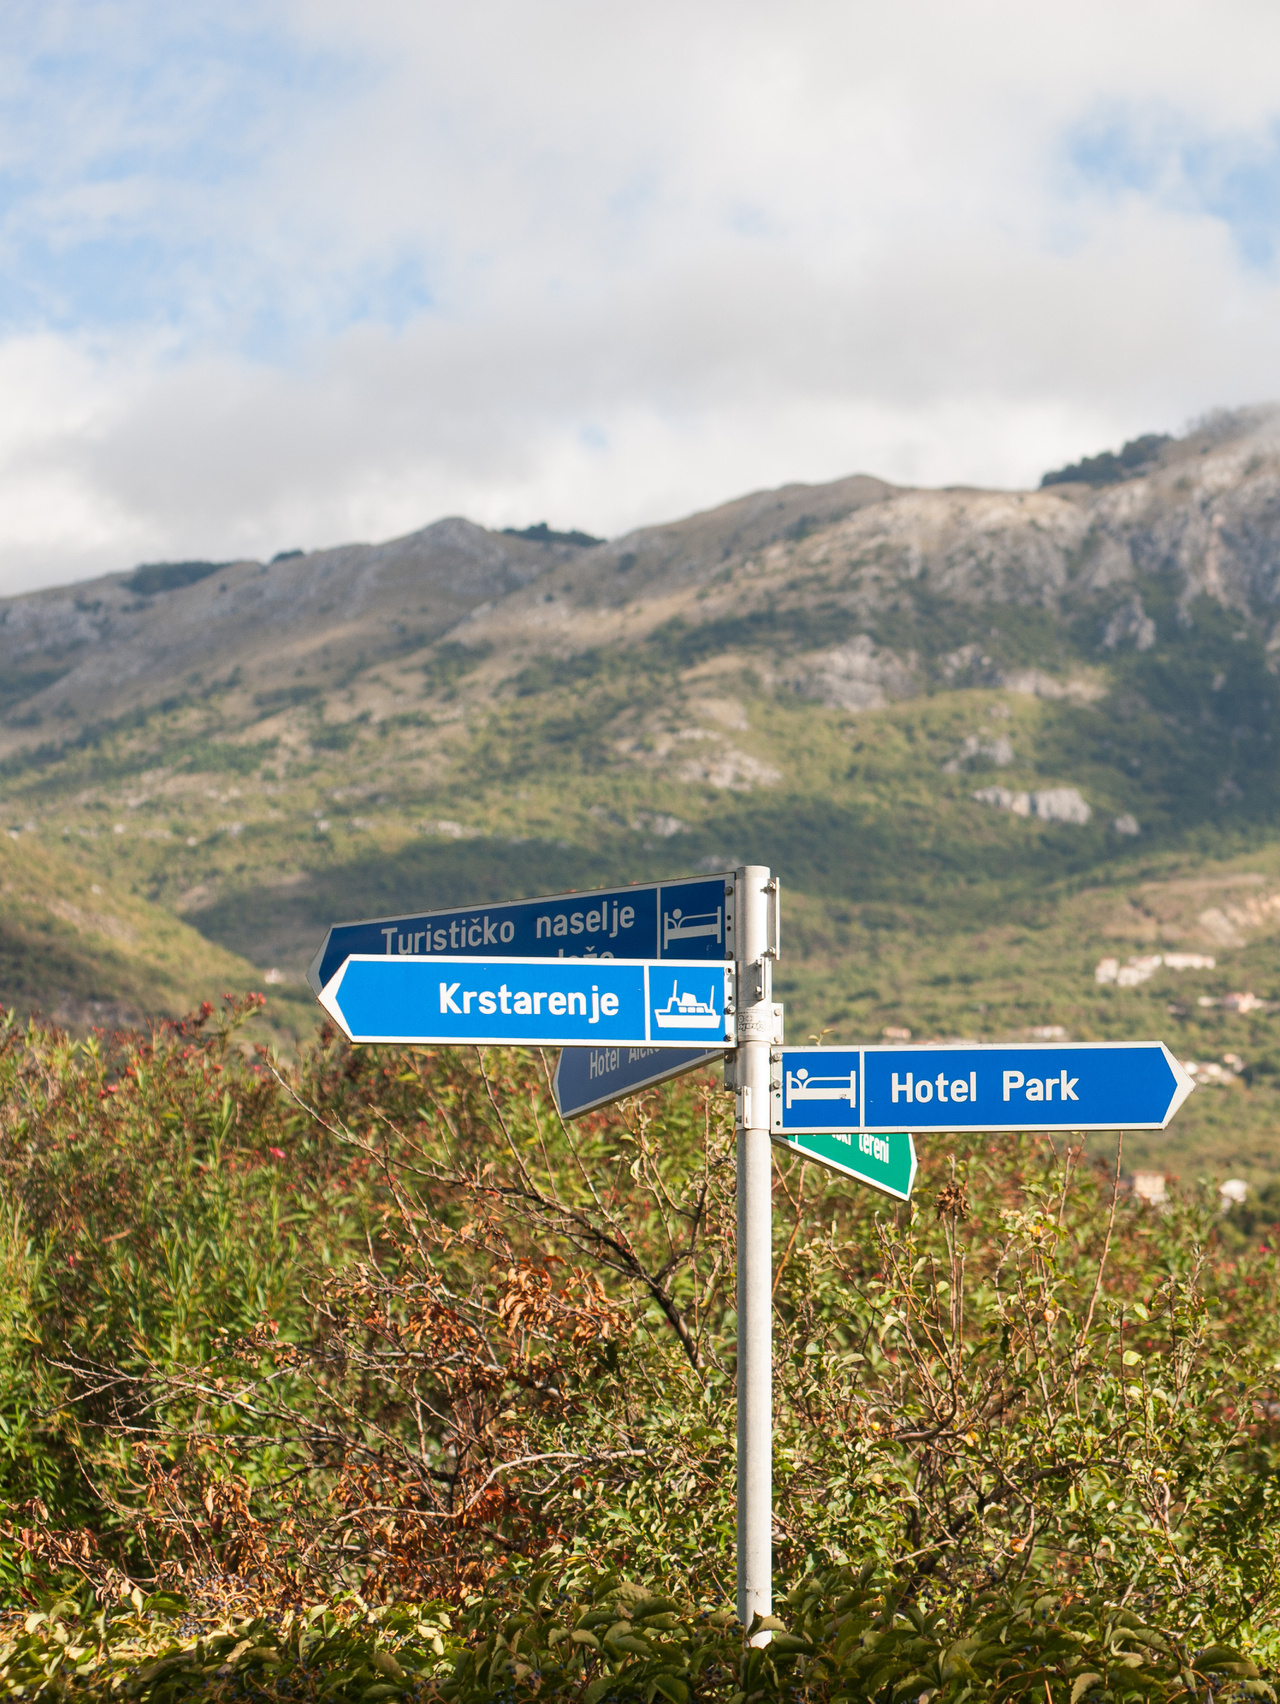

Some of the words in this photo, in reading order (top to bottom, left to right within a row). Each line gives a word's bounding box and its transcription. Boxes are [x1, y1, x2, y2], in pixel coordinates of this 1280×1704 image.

[381, 917, 515, 956] Turističko
[536, 901, 635, 938] naselje
[439, 982, 620, 1024] Krstarenje
[590, 1048, 620, 1080] Hotel
[891, 1071, 977, 1103] Hotel
[1002, 1070, 1080, 1102] Park
